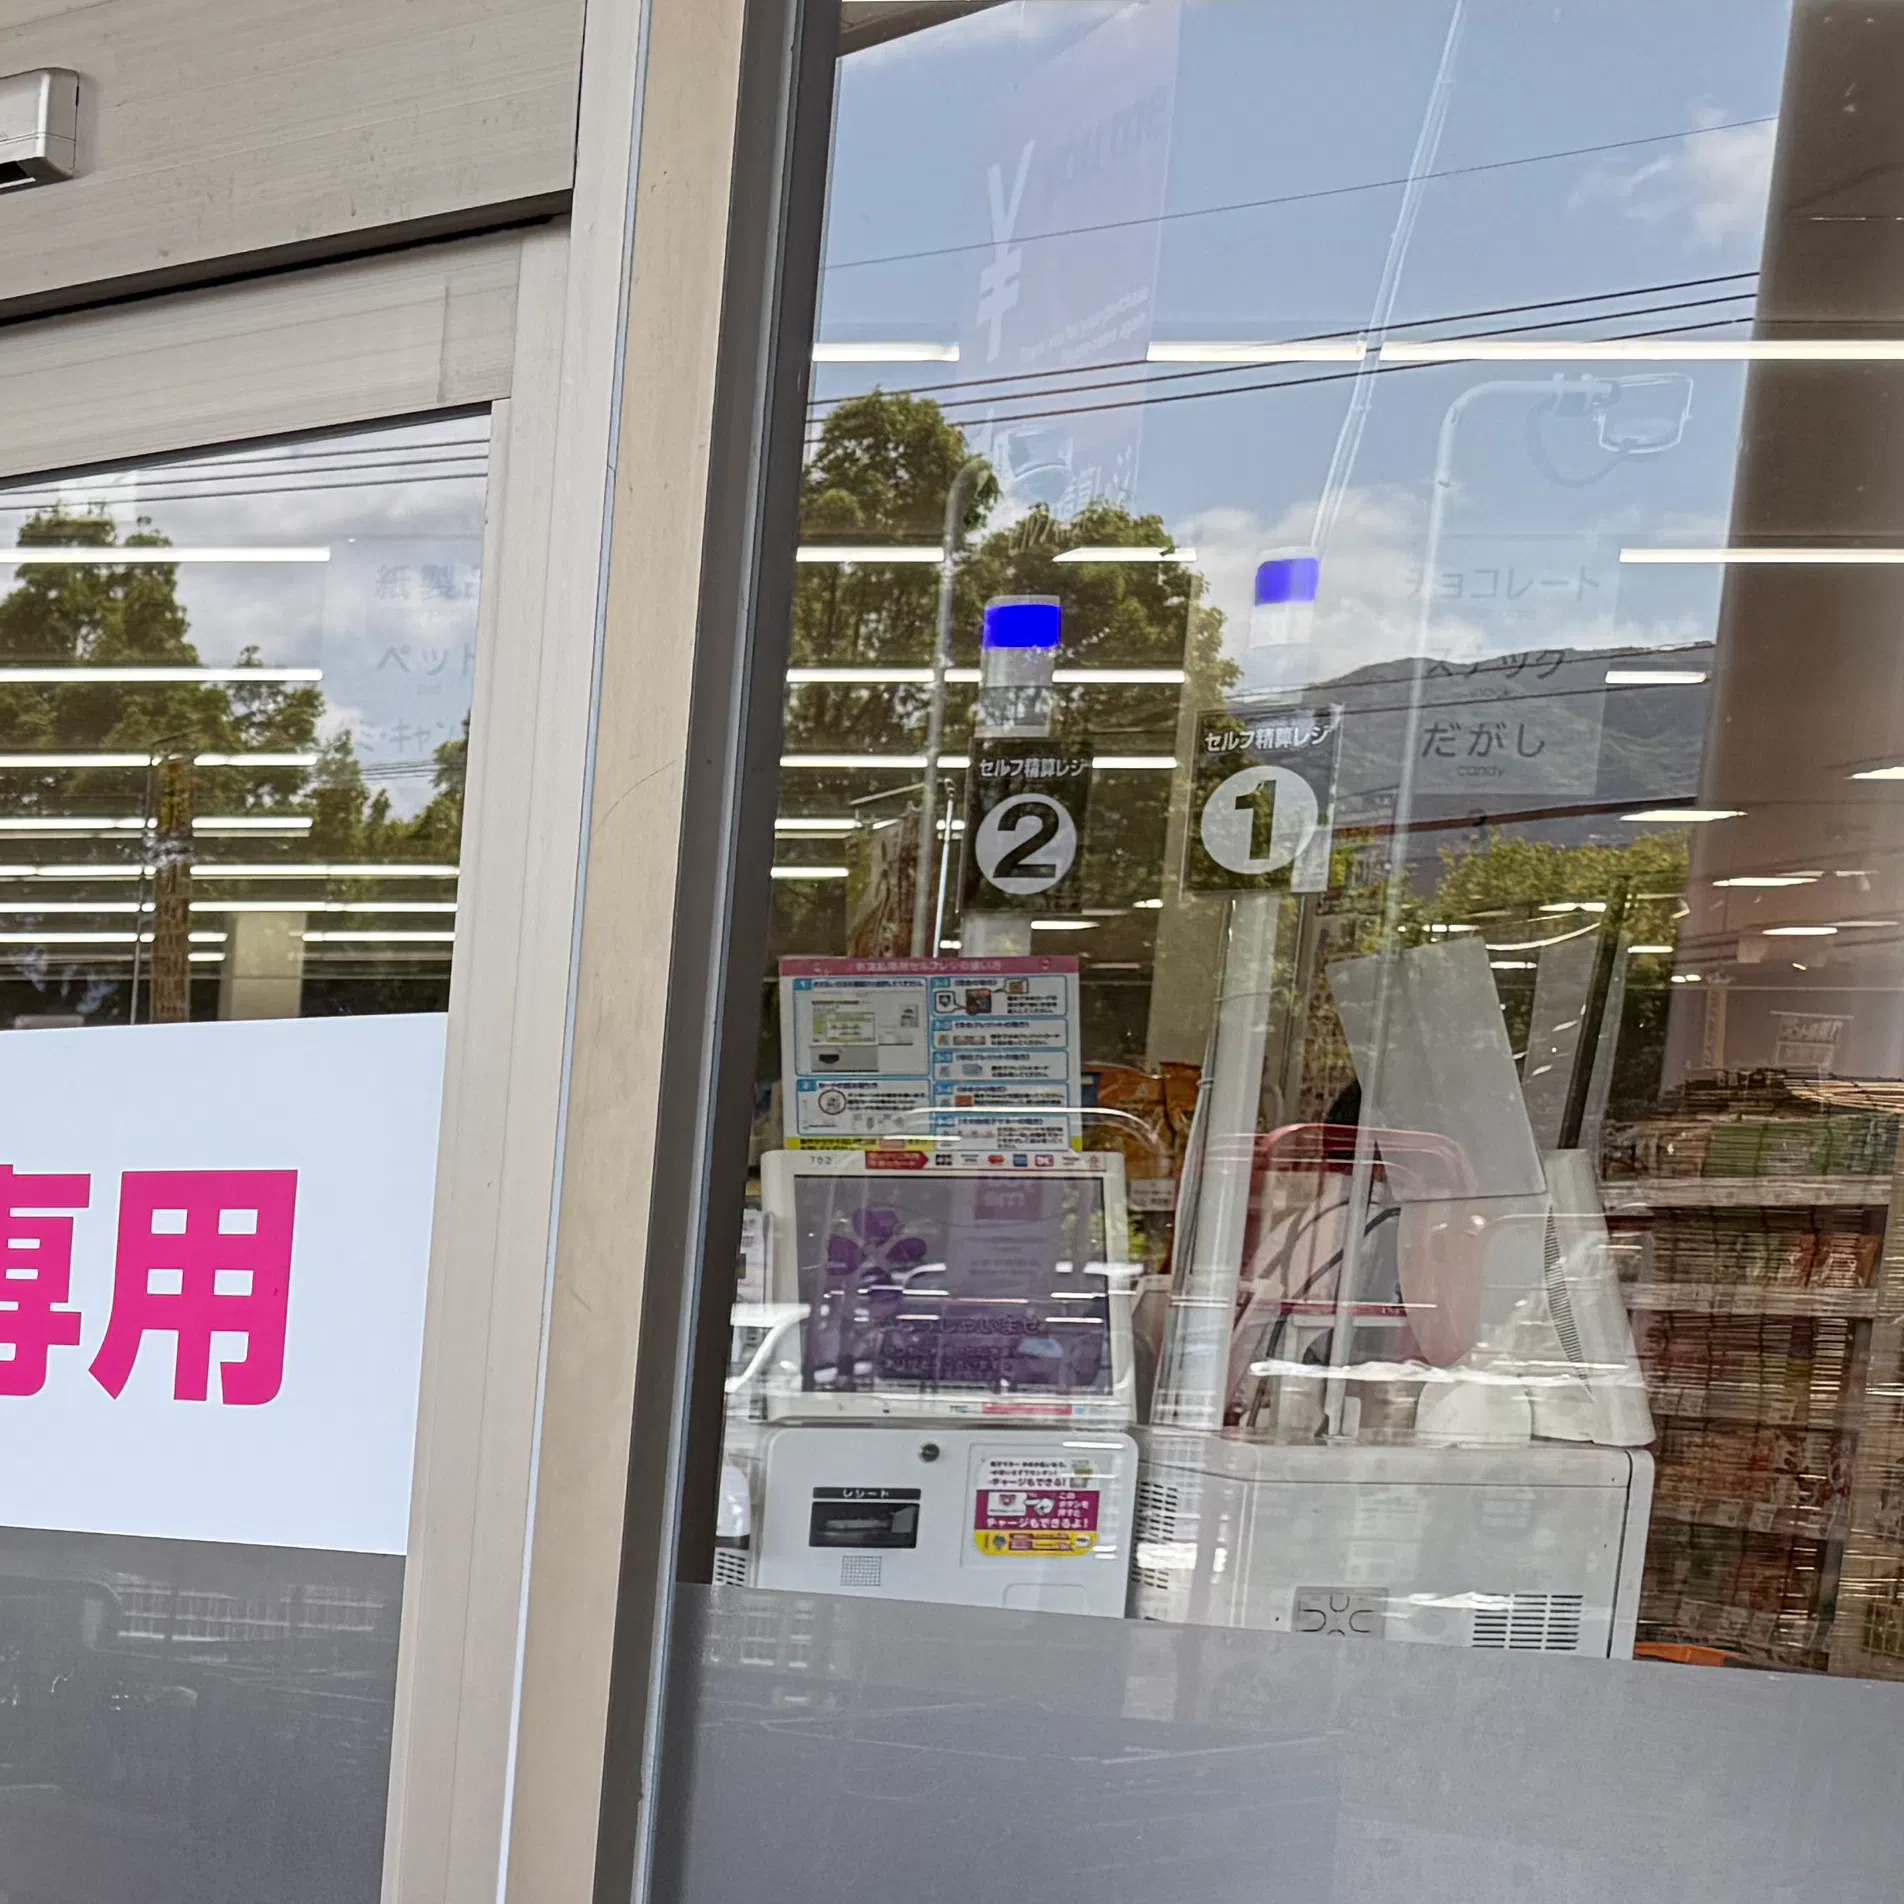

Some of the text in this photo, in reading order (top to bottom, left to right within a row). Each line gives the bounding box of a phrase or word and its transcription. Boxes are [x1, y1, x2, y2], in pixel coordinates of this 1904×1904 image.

[1205, 725, 1334, 753] セルフ精算レジ
[1421, 721, 1546, 758] だがし
[979, 758, 1090, 780] セルフ精算レジ
[1235, 780, 1276, 860] 1
[993, 801, 1060, 878] 2
[843, 1488, 889, 1498] レシート
